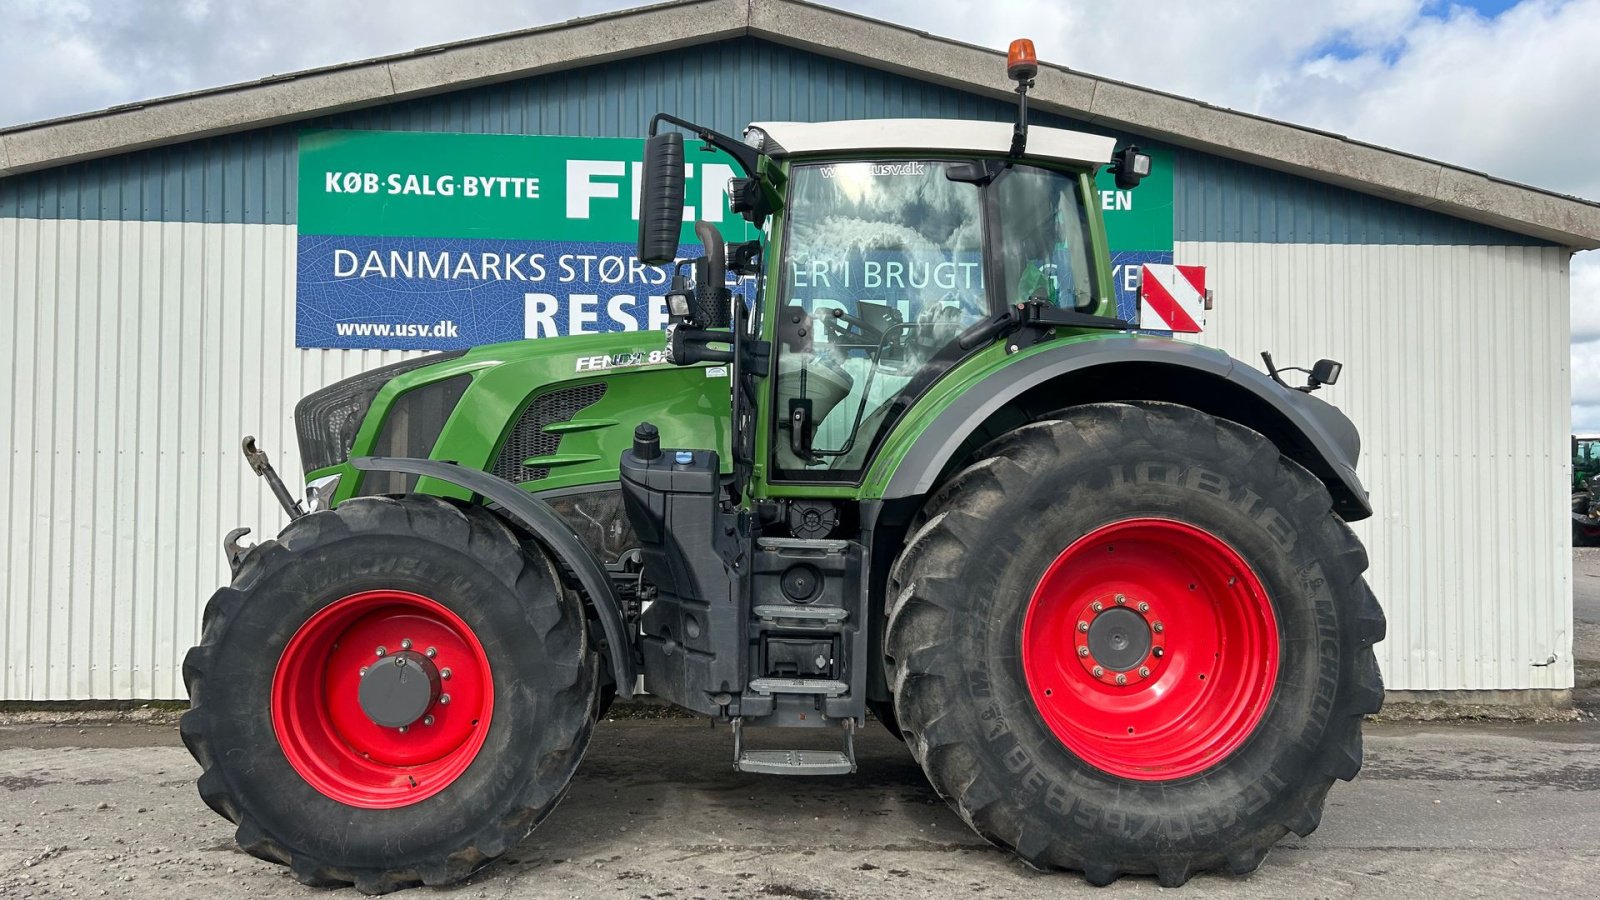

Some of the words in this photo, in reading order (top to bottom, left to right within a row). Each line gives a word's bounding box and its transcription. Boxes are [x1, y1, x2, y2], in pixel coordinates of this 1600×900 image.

[334, 249, 547, 281] DANMARKS
[864, 261, 985, 289] BRUGT
[336, 320, 459, 338] www.usv.dk
[576, 351, 646, 373] FENDT
[1300, 600, 1340, 750] MICHELIN
